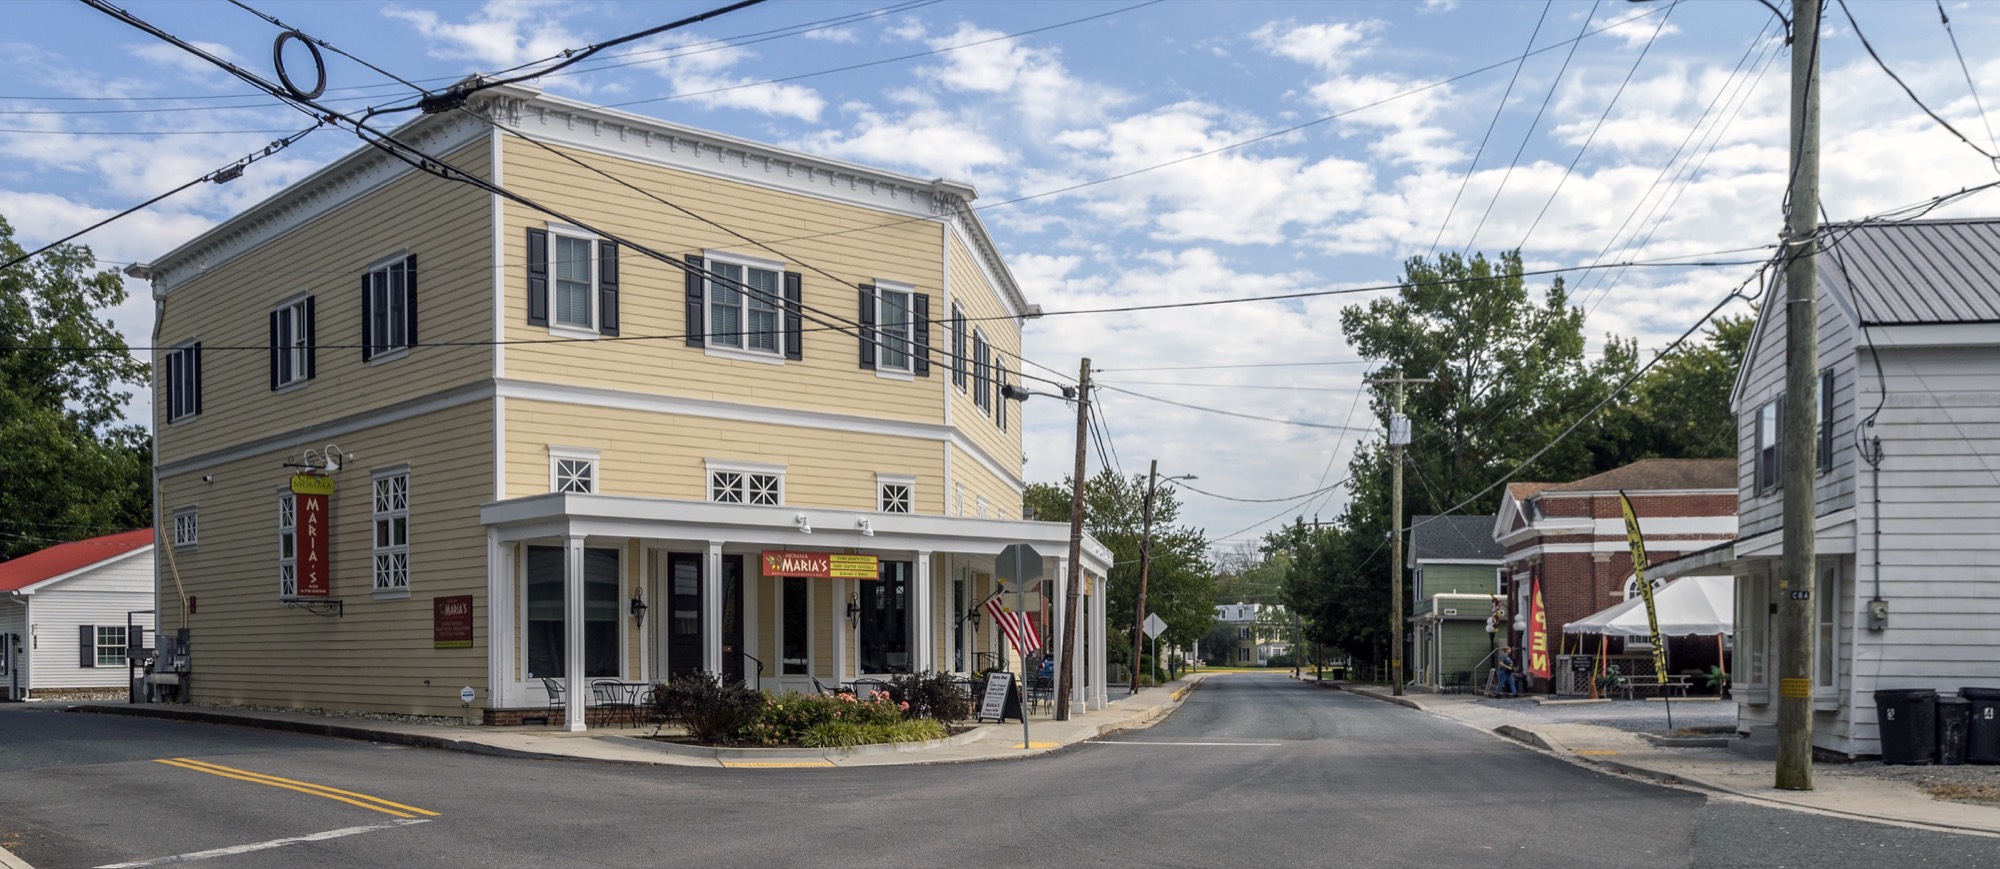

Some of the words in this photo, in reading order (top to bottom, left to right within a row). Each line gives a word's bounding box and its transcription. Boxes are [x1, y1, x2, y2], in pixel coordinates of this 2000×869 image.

[294, 480, 332, 490] MOMMA
[306, 497, 319, 583] MARIA'S
[782, 557, 828, 572] MARIA'S
[445, 603, 467, 616] MARIA'S
[1983, 707, 1993, 719] 4
